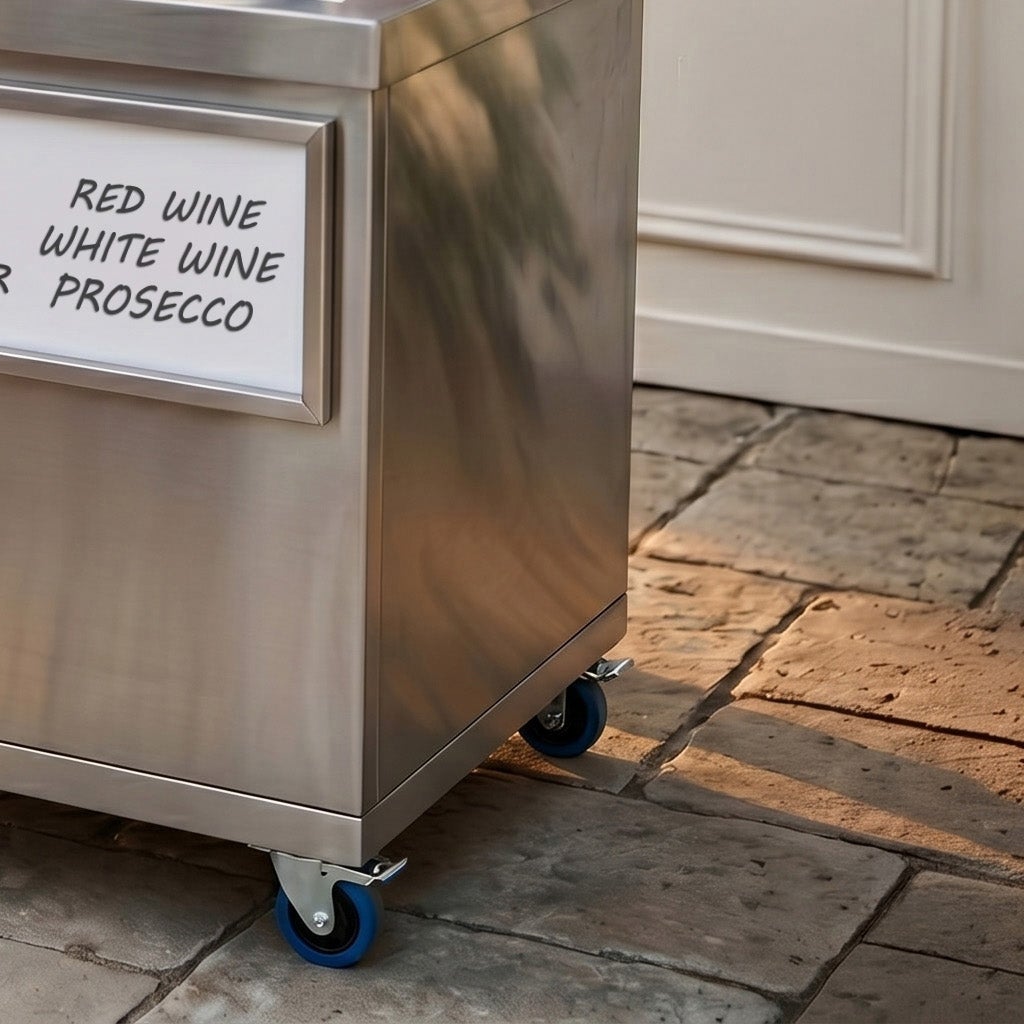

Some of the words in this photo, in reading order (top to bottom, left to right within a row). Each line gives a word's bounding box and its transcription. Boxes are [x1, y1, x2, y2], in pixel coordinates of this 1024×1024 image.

[69, 178, 146, 214] RED
[161, 190, 267, 230] WINE
[39, 224, 166, 268] WHITE
[177, 241, 286, 283] WINE
[49, 272, 254, 333] PROSECCO
